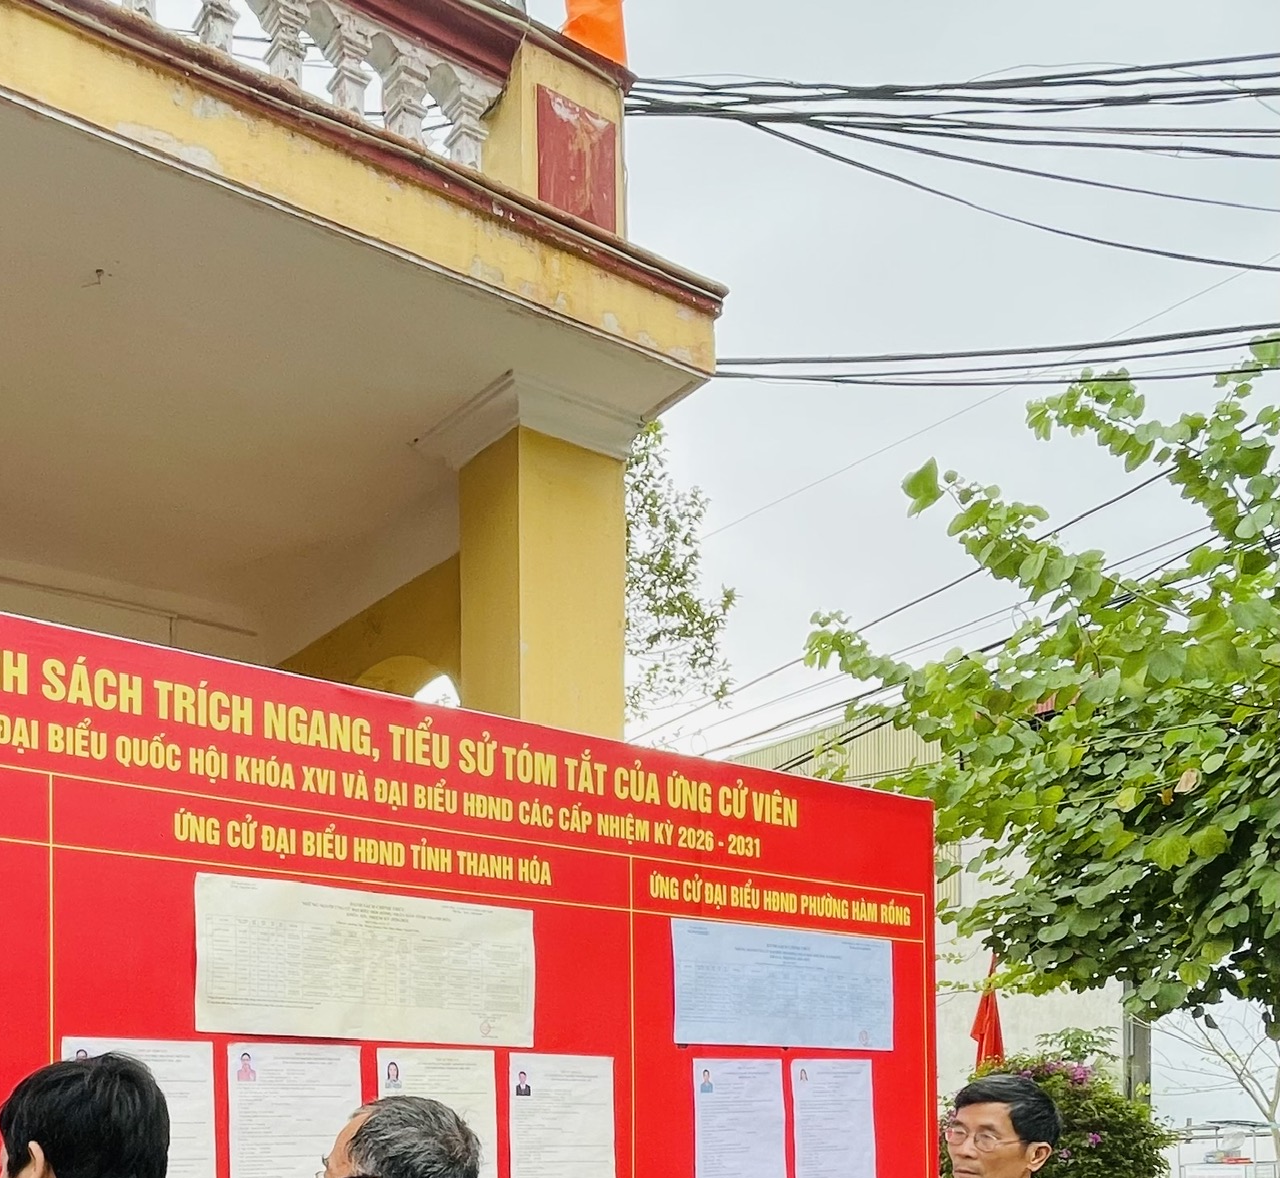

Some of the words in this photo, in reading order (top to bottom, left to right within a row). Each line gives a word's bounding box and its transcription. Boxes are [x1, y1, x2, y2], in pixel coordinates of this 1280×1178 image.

[42, 656, 142, 715] SÁCH
[153, 680, 252, 736] TRÍCH
[264, 701, 379, 763] NGANG,
[389, 716, 449, 769] TIỂU
[459, 731, 497, 776] SỬ
[502, 743, 556, 787] TÓM
[565, 749, 607, 795] TẮT
[614, 760, 660, 805] CỦA
[667, 771, 711, 813] ỨNG
[719, 779, 748, 819] CỬ
[752, 790, 797, 827] VIÊN
[48, 718, 107, 760] BIỂU
[116, 733, 181, 771] QUỐC
[189, 745, 227, 783] HỘI
[236, 755, 295, 789] KHÓA
[302, 766, 335, 795] XVI
[342, 770, 368, 801] VÀ
[374, 778, 407, 806] ĐẠI
[414, 779, 457, 813] BIỂU
[463, 792, 513, 821] HĐND
[519, 799, 553, 828] CÁC
[559, 802, 592, 833] CẤP
[598, 813, 649, 844] NHIỆM
[654, 820, 673, 845] KỲ
[678, 826, 714, 851] 2026
[728, 834, 760, 857] 2031
[175, 808, 220, 845] ỨNG
[227, 814, 257, 849] CỬ
[261, 825, 296, 859] ĐẠI
[303, 823, 347, 860] BIỂU
[354, 837, 405, 867] HĐND
[410, 838, 452, 873] TỈNH
[457, 851, 513, 880] THANH
[518, 855, 551, 885] HÓA
[650, 871, 679, 900] ỨNG
[683, 874, 703, 902] CỬ
[704, 883, 727, 909] ĐẠI
[731, 879, 760, 909] BIỂU
[763, 890, 797, 913] HĐND
[801, 893, 849, 919] PHƯỜNG
[852, 898, 877, 922] HÀM
